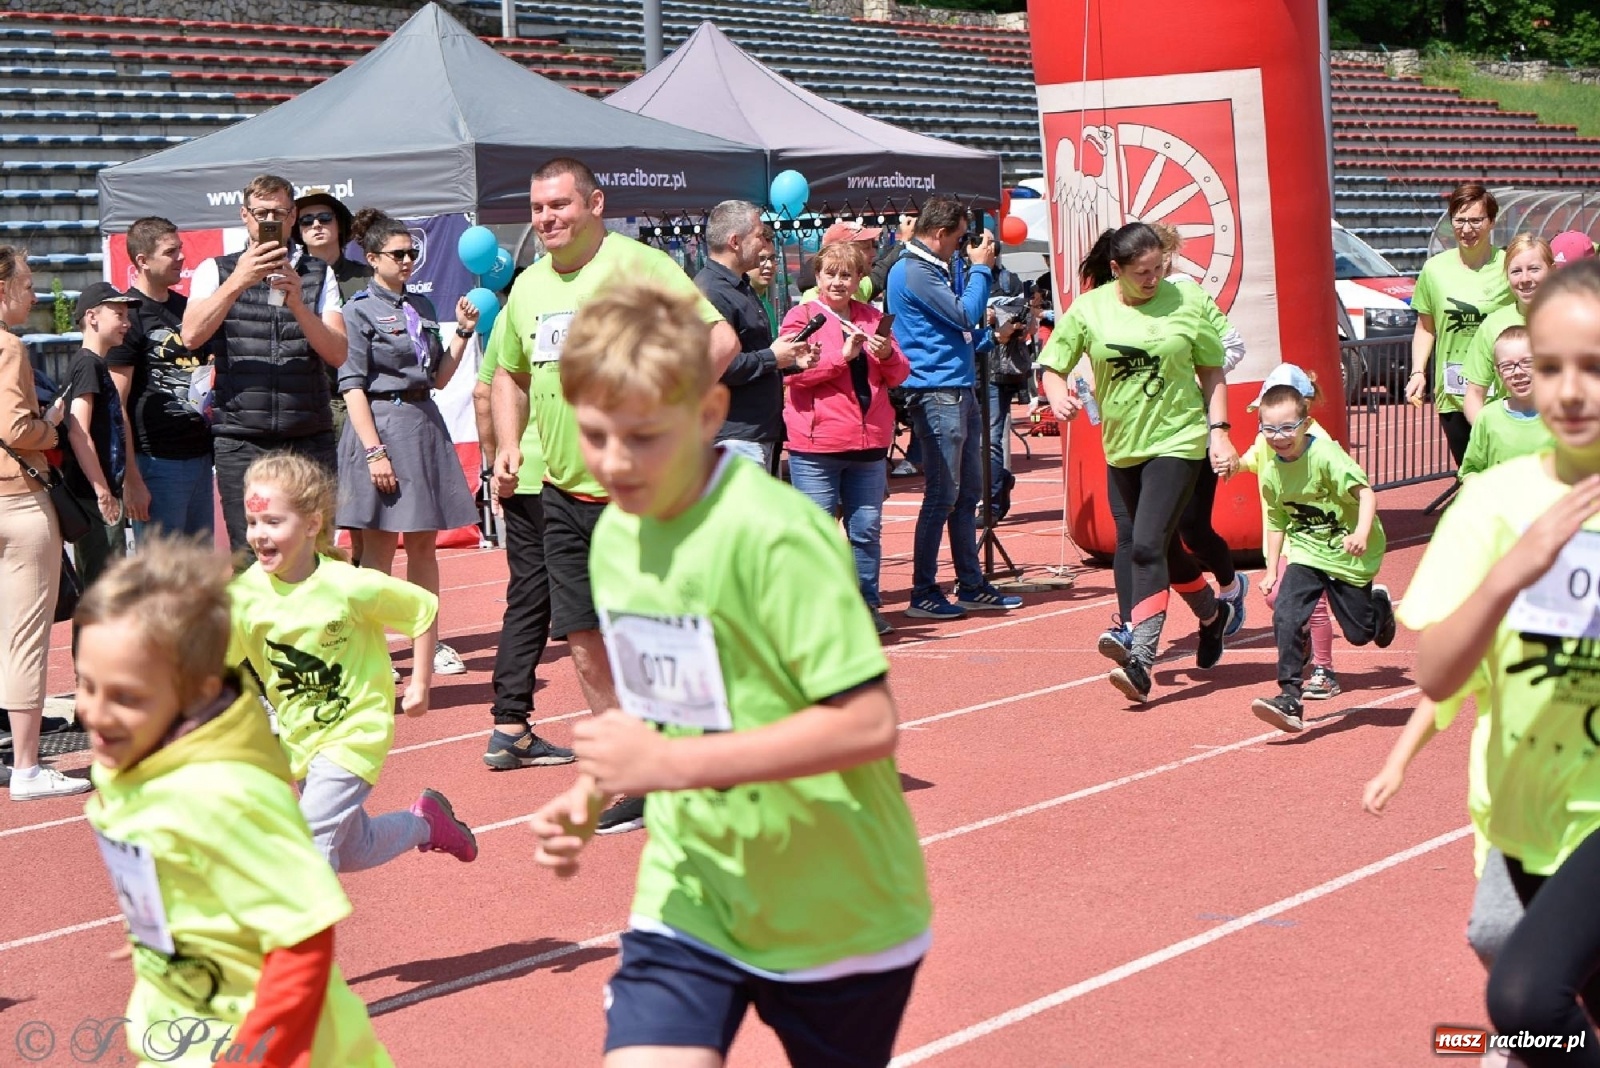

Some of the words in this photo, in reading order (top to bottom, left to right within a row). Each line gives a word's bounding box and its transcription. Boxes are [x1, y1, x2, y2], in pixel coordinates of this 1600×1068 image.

[594, 167, 687, 191] w.raciborz.pl
[847, 171, 936, 192] www.raciborz.pl
[1569, 567, 1600, 600] 0
[639, 652, 677, 687] 017
